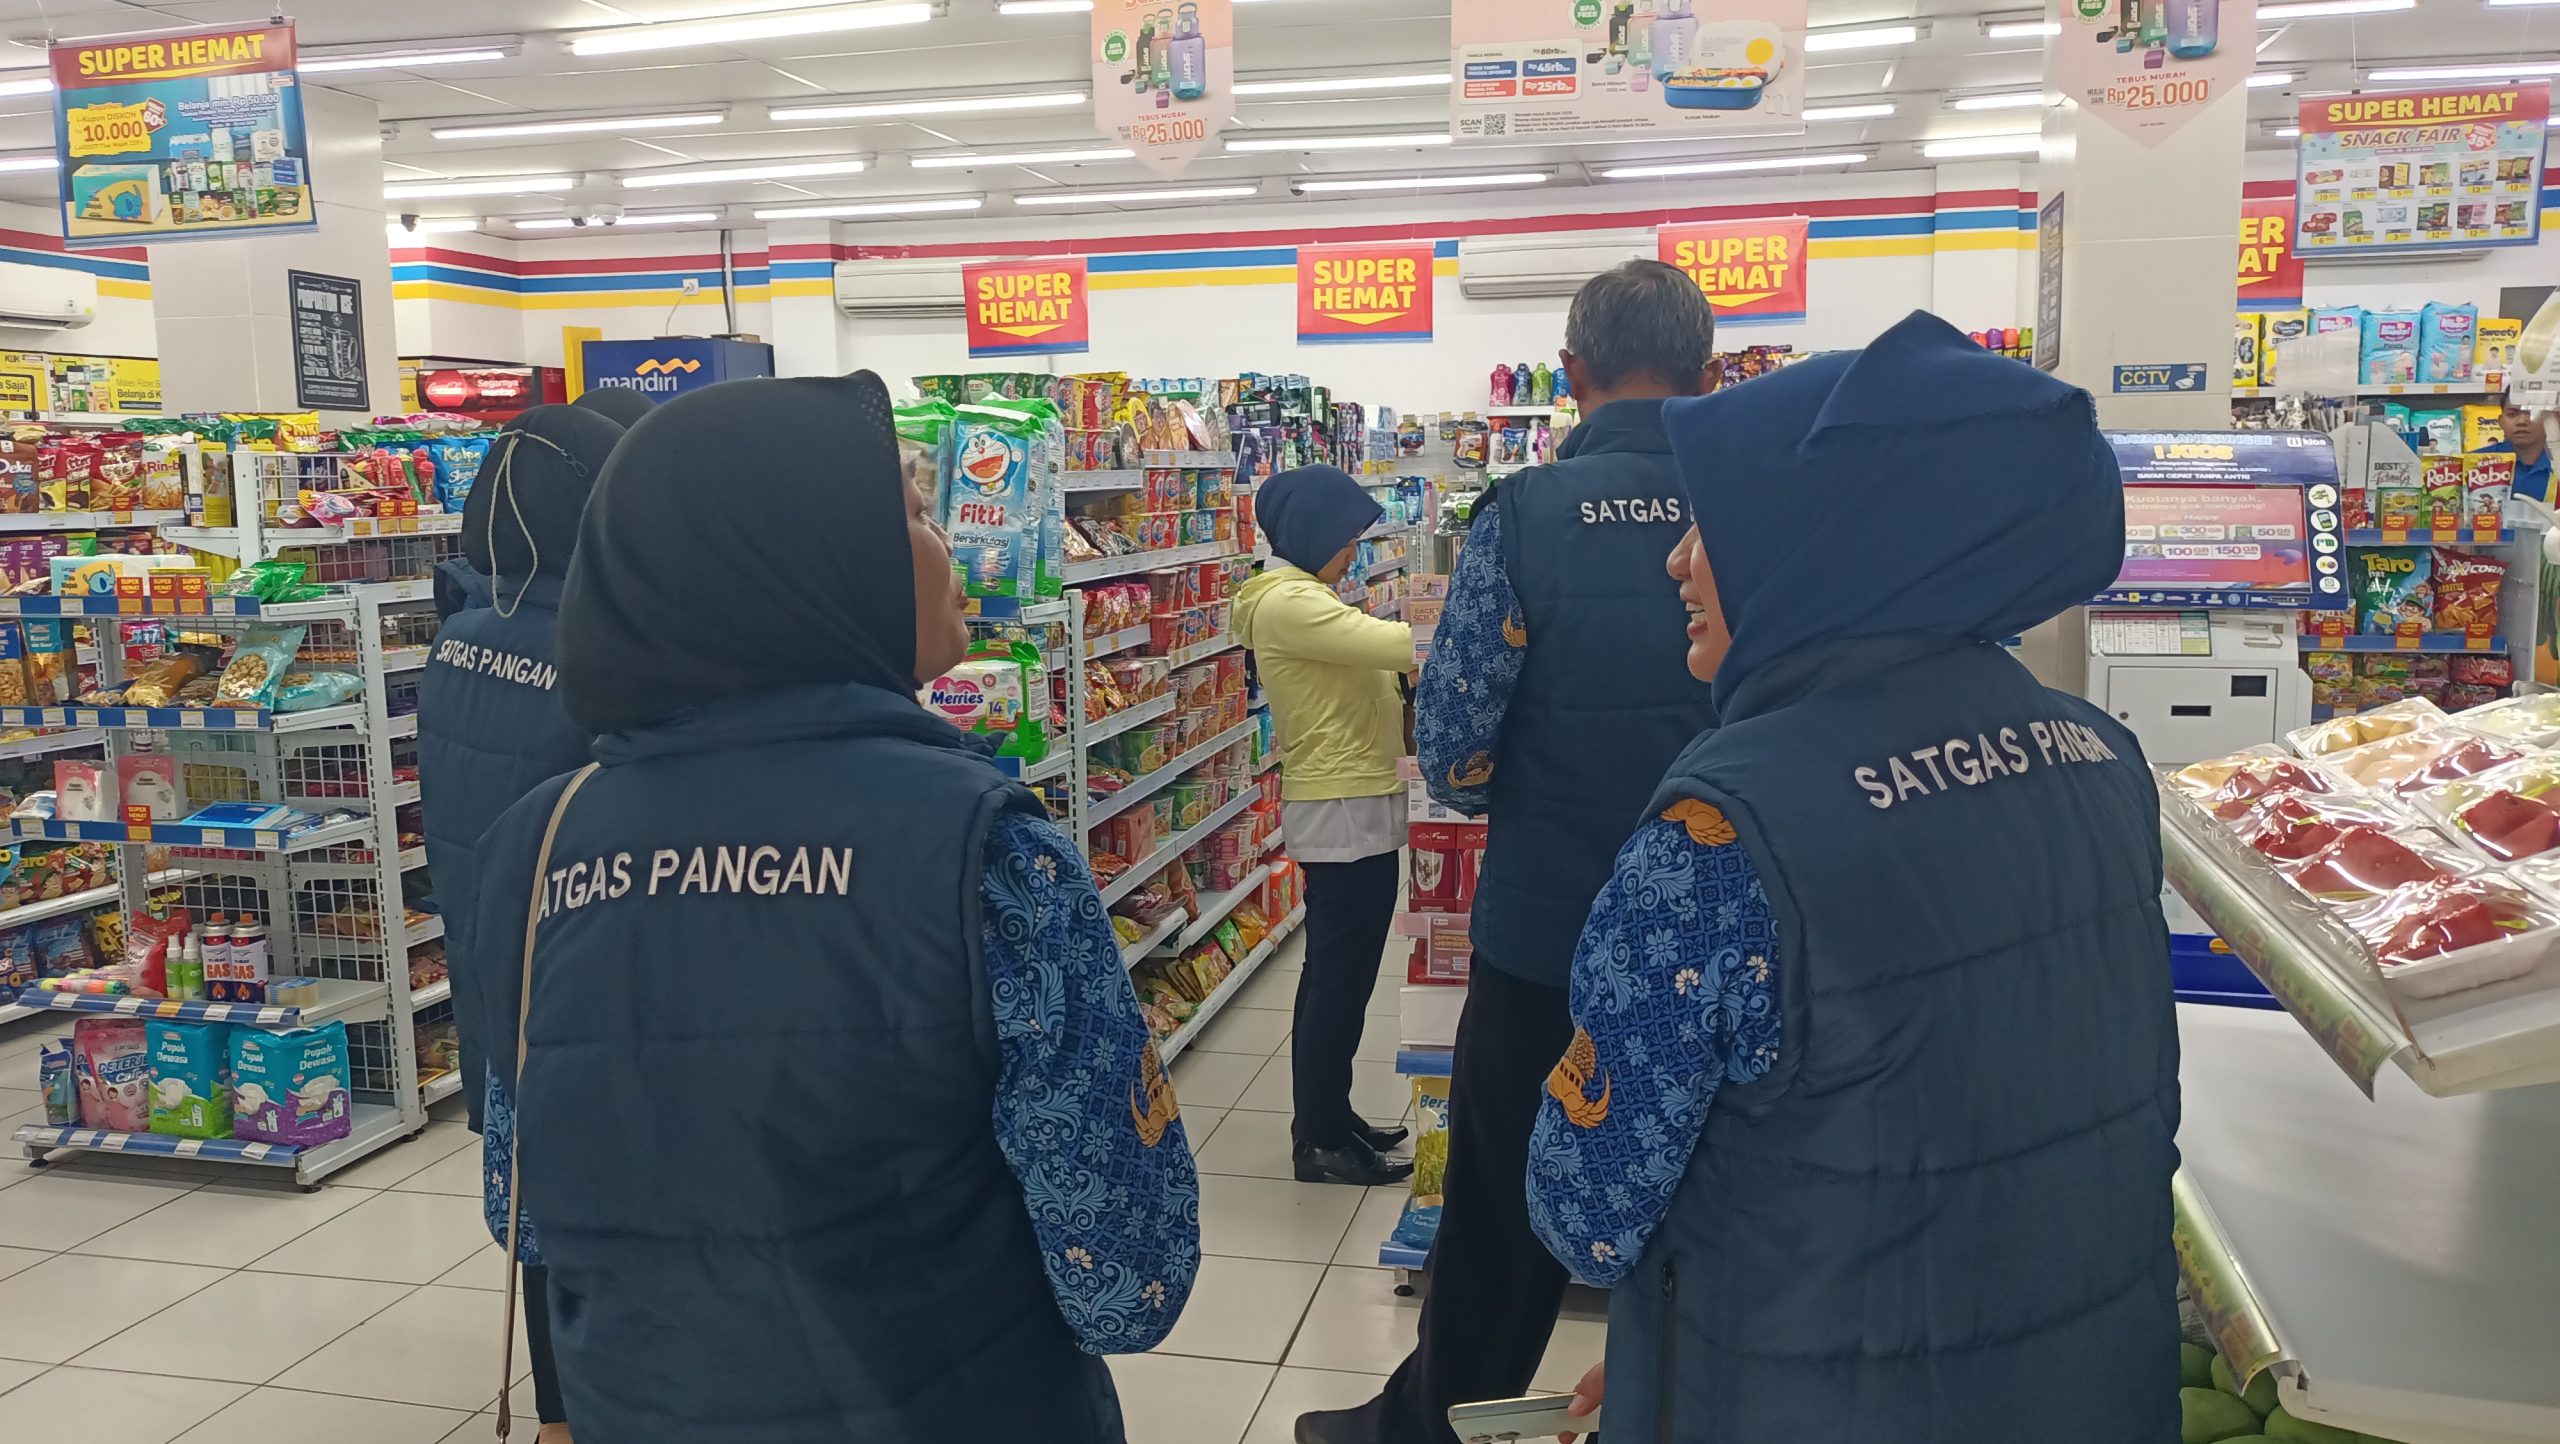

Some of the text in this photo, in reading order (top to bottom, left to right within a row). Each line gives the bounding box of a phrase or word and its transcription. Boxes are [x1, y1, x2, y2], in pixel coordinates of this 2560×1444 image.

[79, 34, 265, 75] SUPER HEMAT
[2116, 71, 2186, 84] TEBUS MURAH
[2328, 92, 2518, 123] SUPER HEMAT
[83, 121, 142, 142] 10.000
[2341, 128, 2461, 148] SNACK FAIR
[1675, 235, 1789, 267] SUPER
[1313, 258, 1416, 286] SUPER
[977, 272, 1072, 301] SUPER
[1313, 285, 1416, 310] HEMAT
[979, 298, 1073, 325] HEMAT
[2480, 327, 2518, 338] Sweety
[5, 380, 27, 391] Saja!
[599, 372, 678, 393] mandiri
[2120, 370, 2170, 385] CCTV
[117, 389, 146, 400] Belanja
[147, 390, 155, 398] di
[0, 458, 32, 474] Deka
[2468, 467, 2511, 488] Rebo
[960, 503, 1005, 526] Fitti
[1580, 498, 1680, 524] SATGAS
[2258, 528, 2275, 536] 50
[2167, 547, 2192, 556] 100
[2216, 546, 2241, 555] 150
[2361, 553, 2415, 572] Taro
[436, 638, 557, 691] SATGAS PANGAN
[930, 691, 984, 705] Merries
[988, 701, 1004, 714] 14
[1855, 727, 2029, 808] SATGAS
[538, 845, 853, 923] ATGAS PANGAN
[207, 964, 230, 978] GAS
[234, 965, 255, 979] GAS
[162, 1042, 185, 1053] Popok
[304, 1044, 332, 1058] Popok
[157, 1052, 188, 1063] Dewasa
[300, 1055, 336, 1070] Dewasa
[238, 1061, 265, 1073] Dewasa
